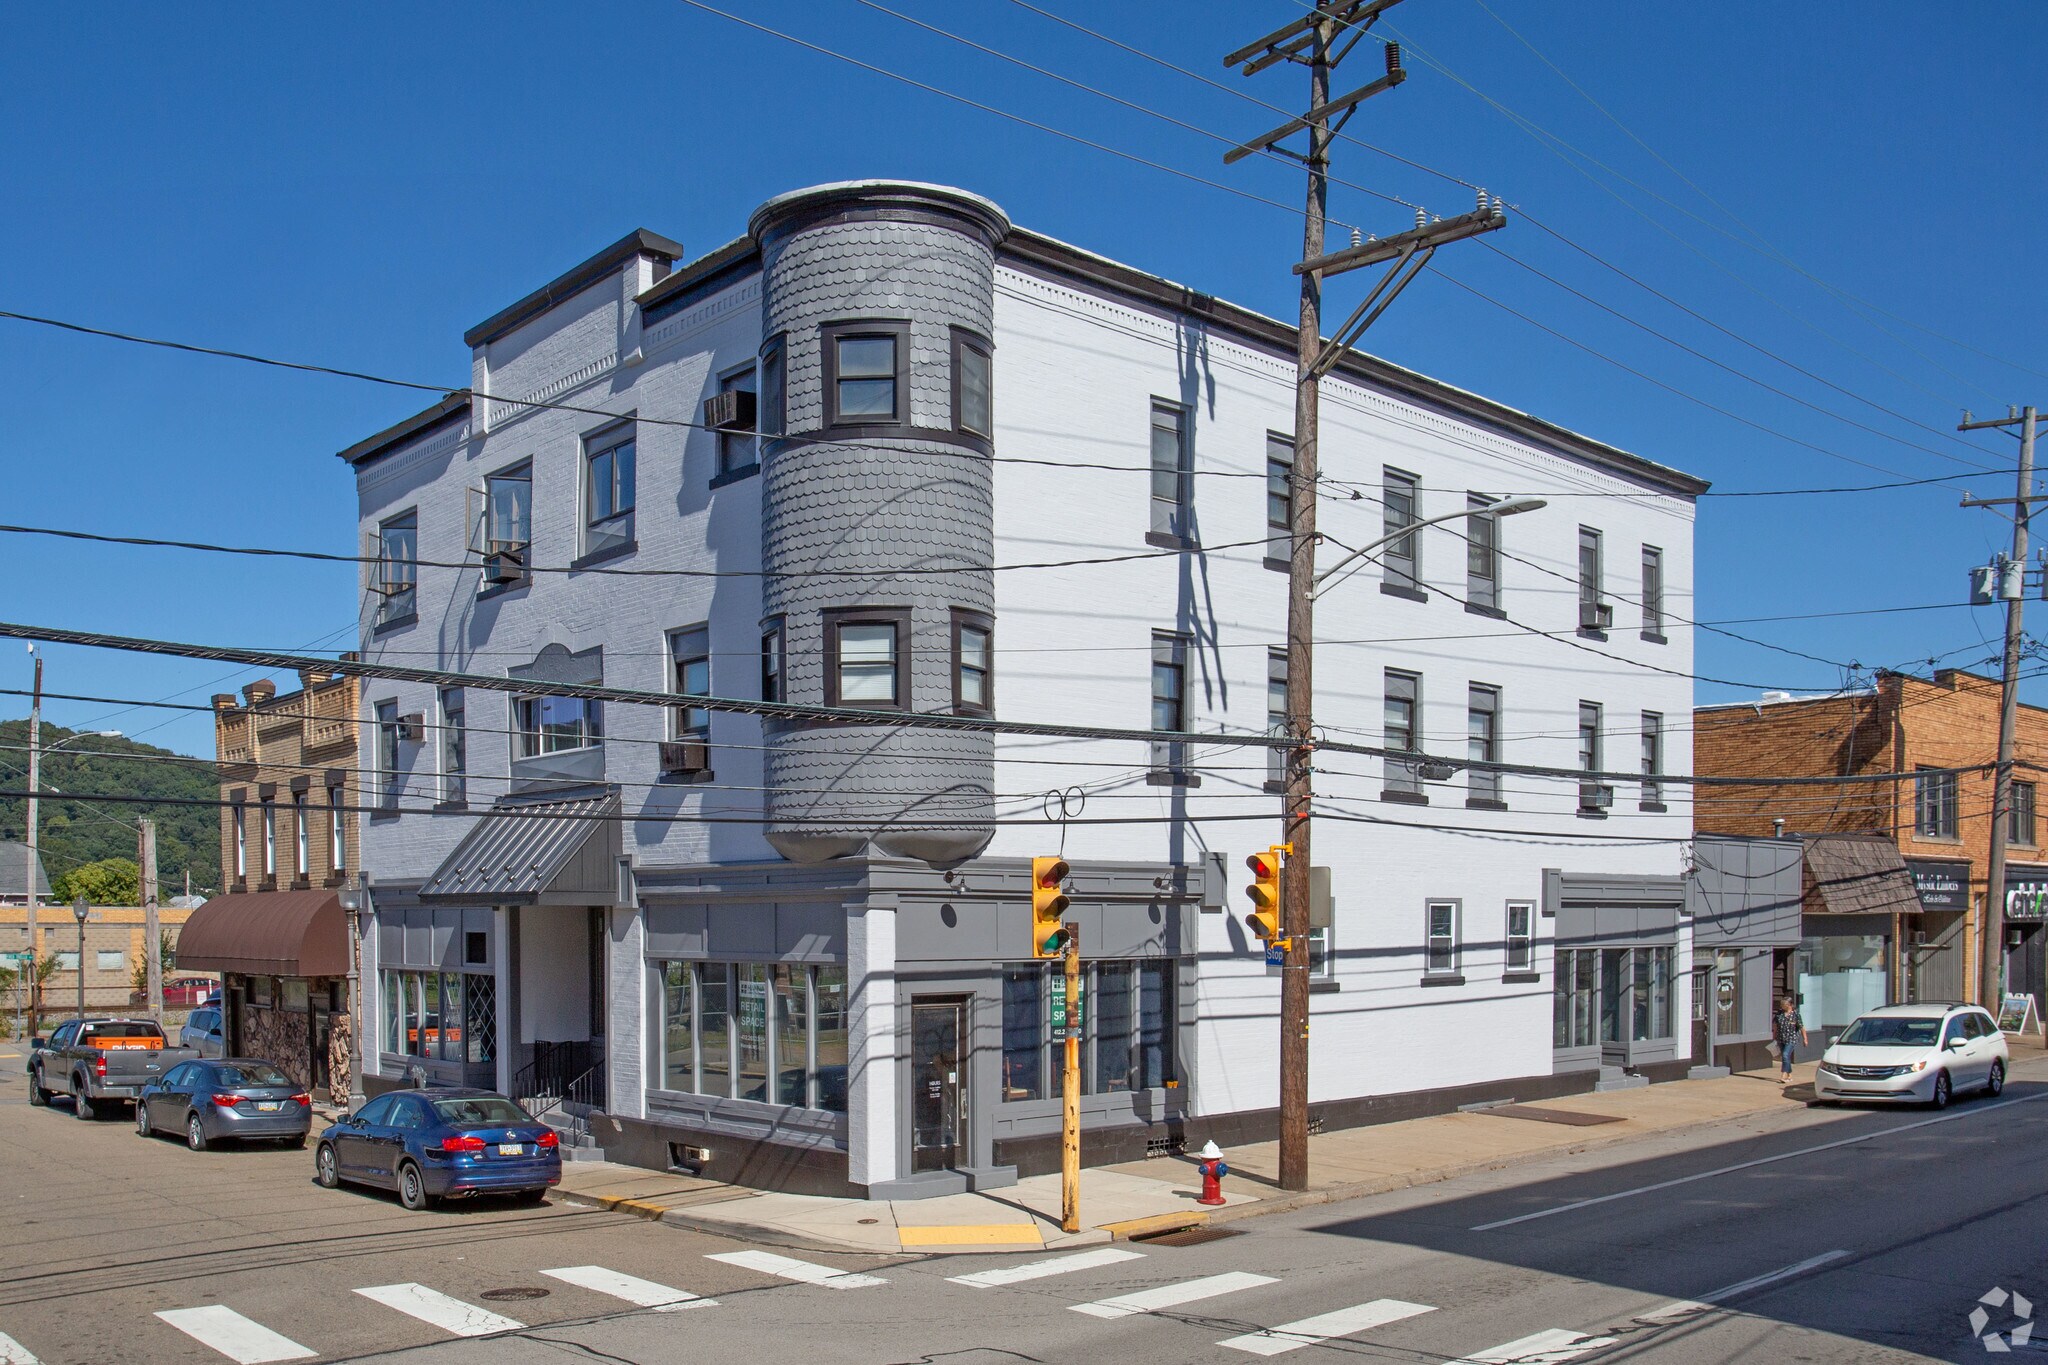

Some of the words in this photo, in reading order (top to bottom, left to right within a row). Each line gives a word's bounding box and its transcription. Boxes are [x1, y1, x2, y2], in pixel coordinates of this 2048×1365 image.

[1266, 948, 1283, 962] Stop
[740, 1001, 765, 1013] RETAIL
[740, 1016, 765, 1028] SPACE
